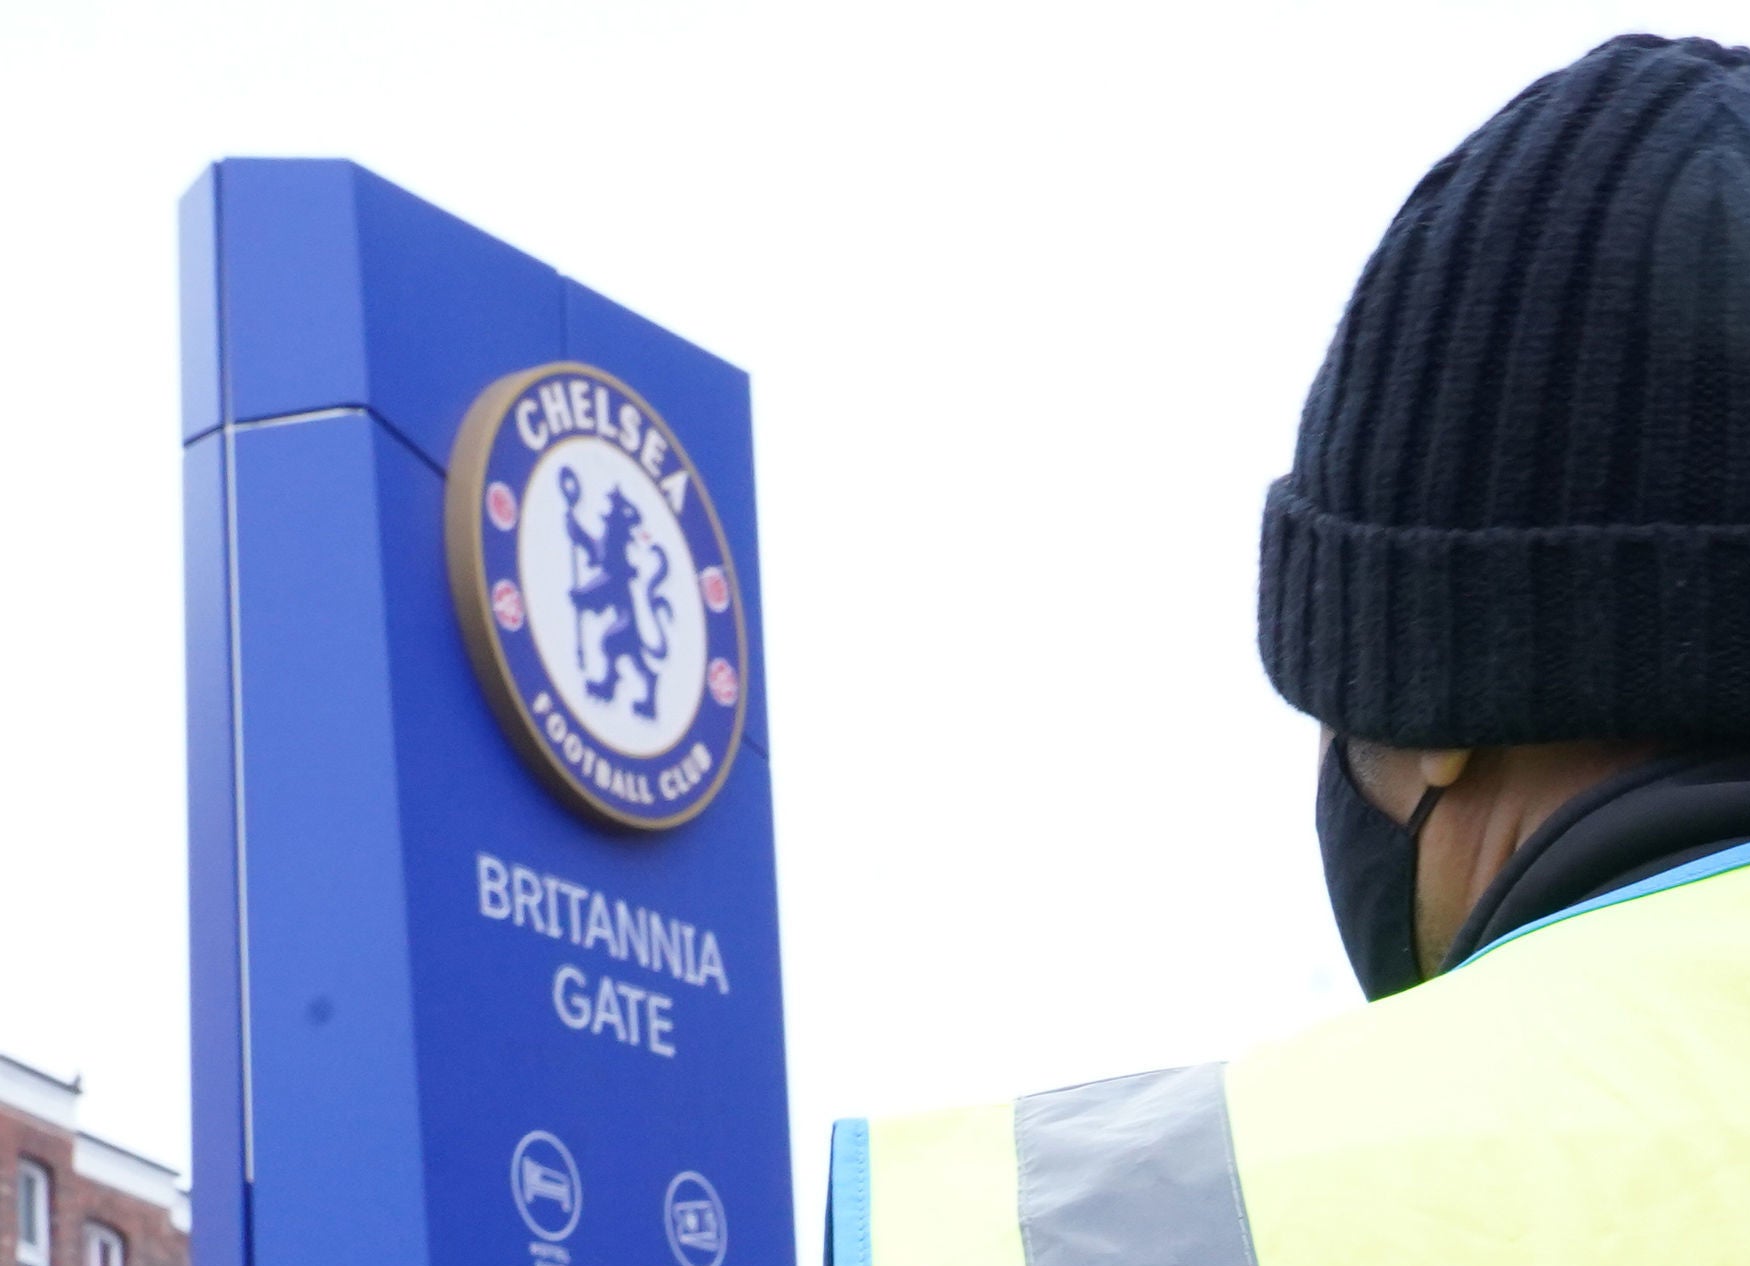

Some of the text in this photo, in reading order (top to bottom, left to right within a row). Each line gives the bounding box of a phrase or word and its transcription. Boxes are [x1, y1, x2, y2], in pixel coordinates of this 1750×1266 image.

[514, 379, 690, 516] CHELSEA
[532, 692, 712, 805] FOOTBALL CLUB
[476, 853, 731, 995] BRITANNIA
[552, 963, 677, 1058] GATE
